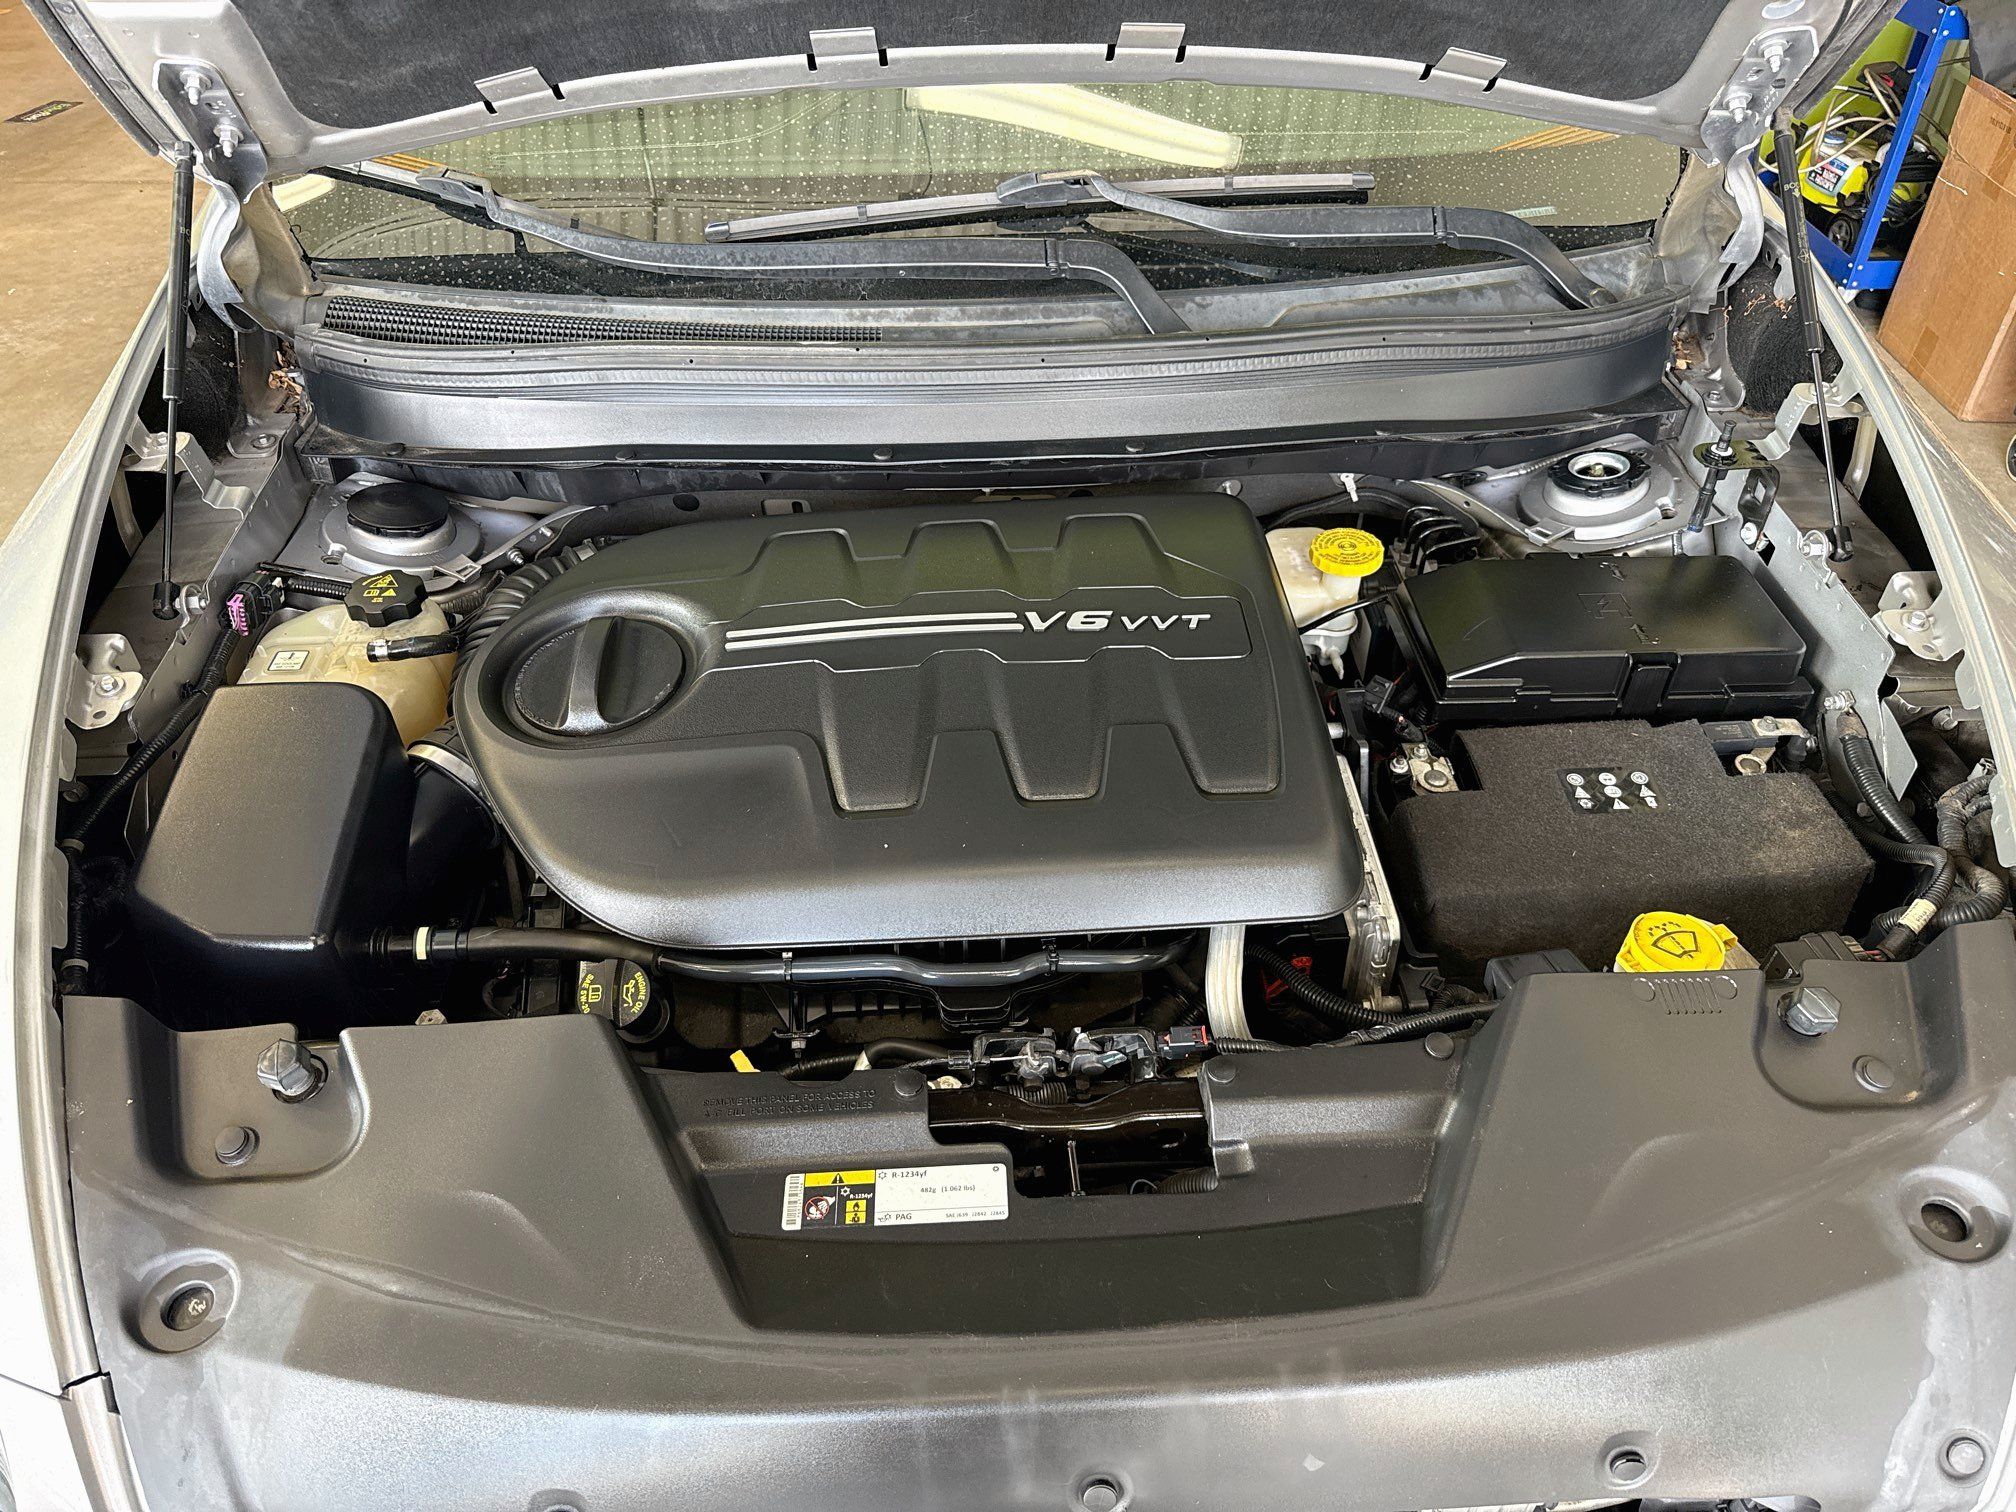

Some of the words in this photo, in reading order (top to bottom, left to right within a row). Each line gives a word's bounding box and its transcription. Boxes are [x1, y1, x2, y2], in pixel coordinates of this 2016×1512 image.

[1025, 610, 1114, 632] V6
[1120, 613, 1211, 631] VVT
[582, 973, 595, 989] SAE
[634, 971, 647, 1001] ENGINE
[631, 1001, 643, 1013] OIL
[745, 1096, 767, 1106] THIS
[769, 1094, 800, 1104] PANEL
[803, 1093, 822, 1102] FOR
[824, 1091, 861, 1100] ACCESS
[863, 1089, 876, 1098] TO
[727, 1107, 746, 1116] FILL
[750, 1106, 776, 1116] PORT
[779, 1105, 794, 1114] ON
[796, 1103, 824, 1113] SOME
[827, 1101, 874, 1111] VEHICLES
[892, 1170, 928, 1179] R-1234yf
[920, 1186, 937, 1194] 482g
[895, 1212, 912, 1221] PAG
